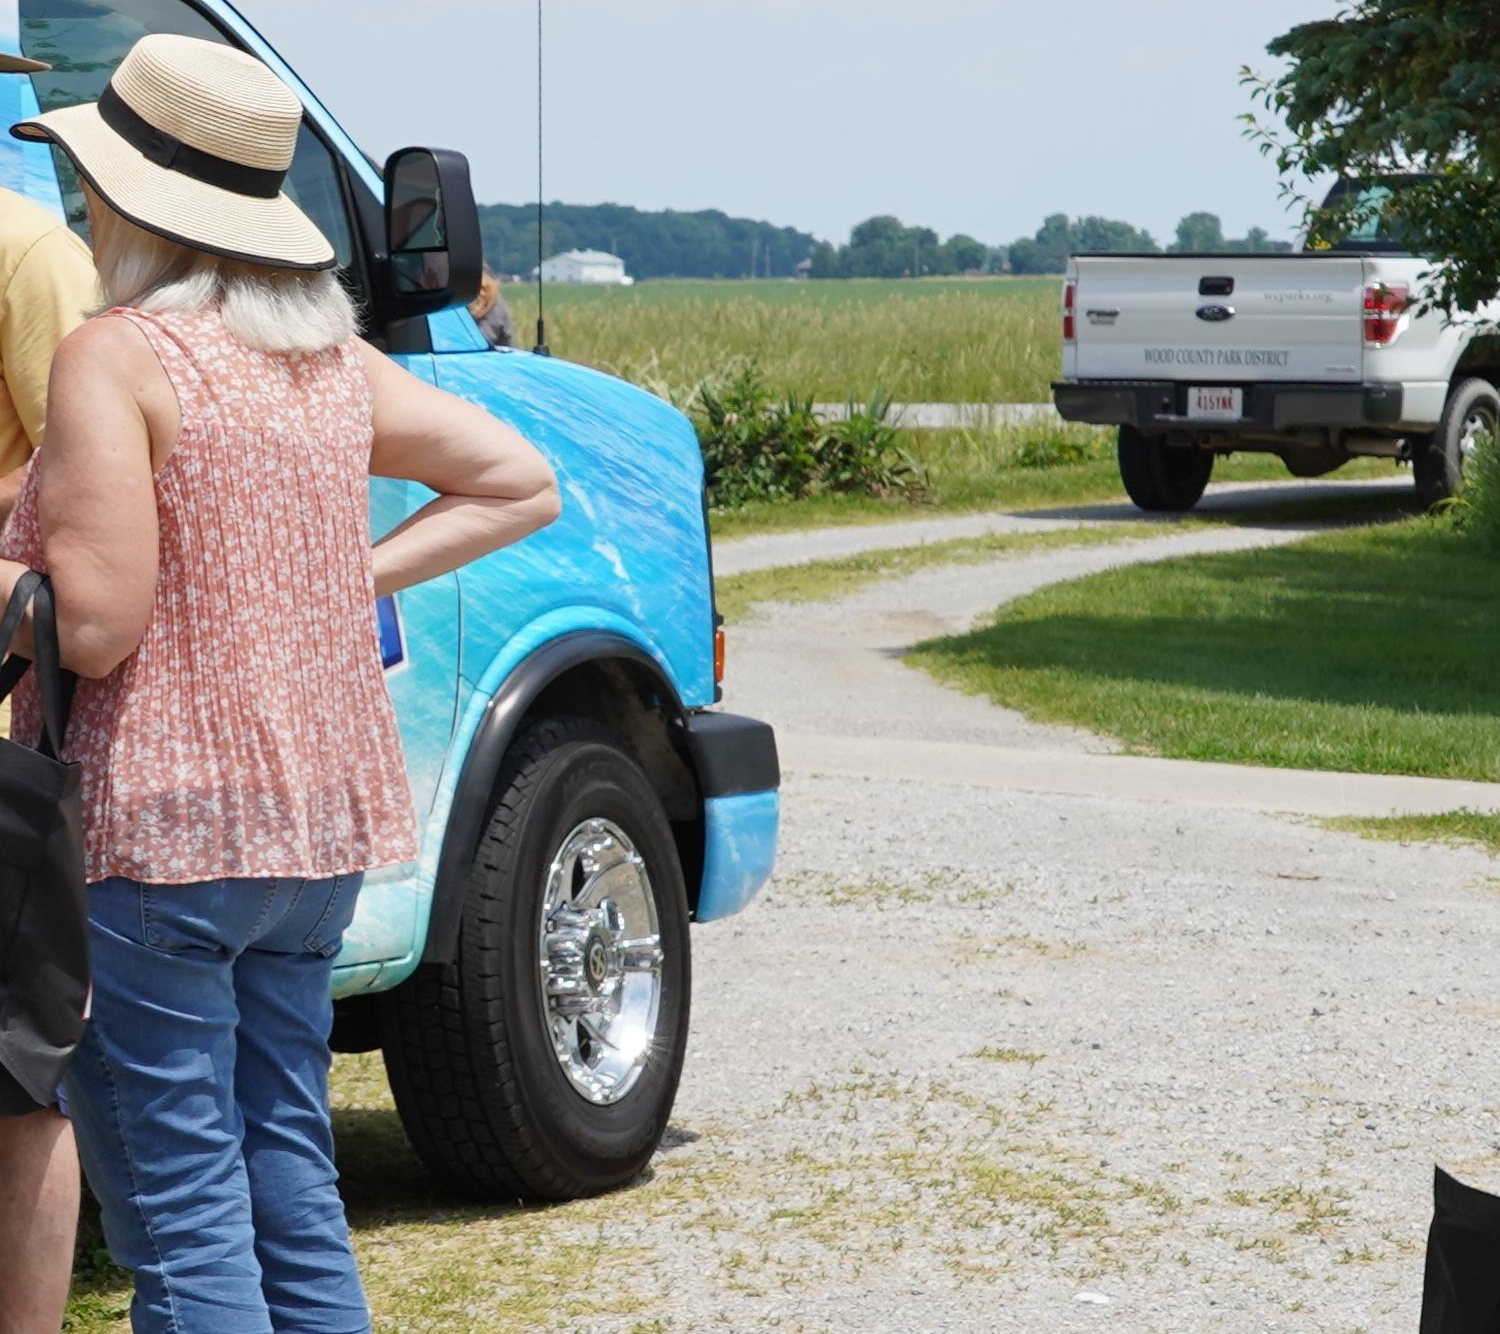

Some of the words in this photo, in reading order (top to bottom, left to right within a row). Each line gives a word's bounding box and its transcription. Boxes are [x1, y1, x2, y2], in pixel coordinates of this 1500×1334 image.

[1144, 347, 1174, 364] WOOD
[1176, 348, 1214, 365] COUNTY
[1217, 349, 1243, 365] PARK
[1245, 350, 1290, 366] DISTRICT
